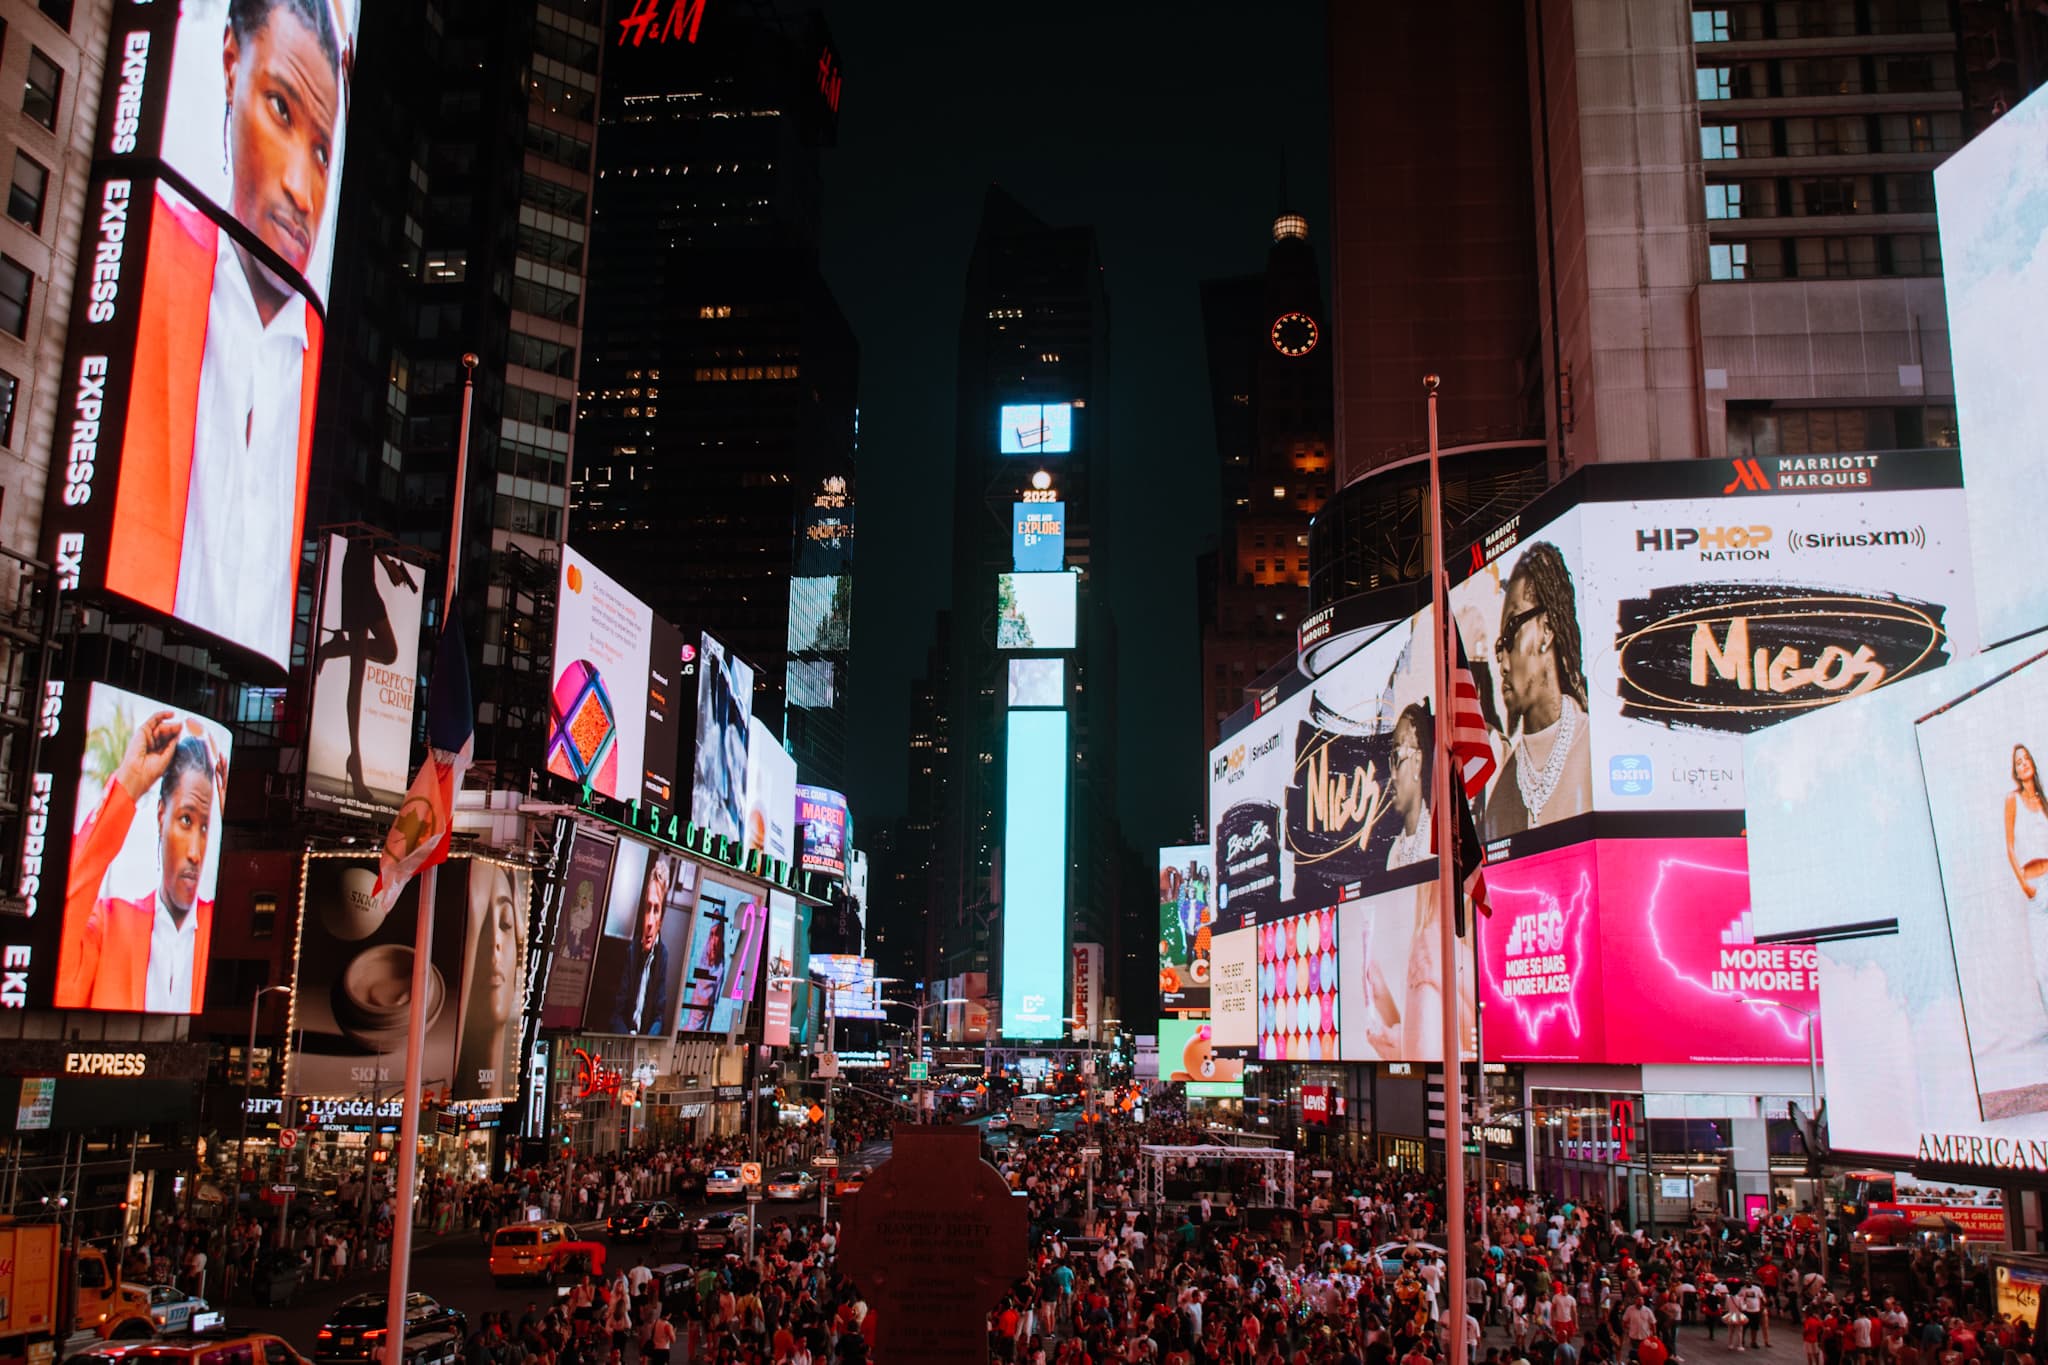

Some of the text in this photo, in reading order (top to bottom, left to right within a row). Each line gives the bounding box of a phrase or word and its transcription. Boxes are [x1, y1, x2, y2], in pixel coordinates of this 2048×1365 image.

[618, 0, 706, 48] H&M
[110, 31, 151, 156] EXPRESS
[86, 178, 132, 325] EXPRESS
[62, 355, 108, 507] EXPRESS
[1779, 455, 1879, 471] MARRIOTT
[1779, 471, 1869, 488] MARQUIS
[1022, 490, 1057, 503] 2022
[1017, 521, 1061, 536] EXPLORE
[1485, 514, 1521, 548] MARRIOTT
[1485, 532, 1517, 562] MARQUIS
[1700, 549, 1770, 563] NATION
[1302, 607, 1336, 634] MARRIOTT
[366, 665, 415, 695] PERFECT
[379, 685, 413, 712] CRIME
[1672, 767, 1734, 783] LISTEN
[802, 802, 844, 826] MACBETH
[632, 798, 696, 850] 1540
[701, 829, 812, 893] BROADWAY
[730, 902, 768, 1002] 21
[1721, 949, 1818, 970] MORE 5G
[1506, 955, 1566, 978] MORE 5G BARS
[1503, 974, 1570, 996] IN MORE PLACES
[1711, 970, 1735, 991] IN
[1740, 970, 1804, 991] MORE
[66, 1053, 146, 1076] EXPRESS
[311, 1100, 403, 1118] LUGGAGE
[1472, 1126, 1513, 1145] SEPHORA
[1611, 1100, 1633, 1161] T
[1916, 1132, 2048, 1172] AMERICAN
[1910, 1210, 1928, 1218] THE
